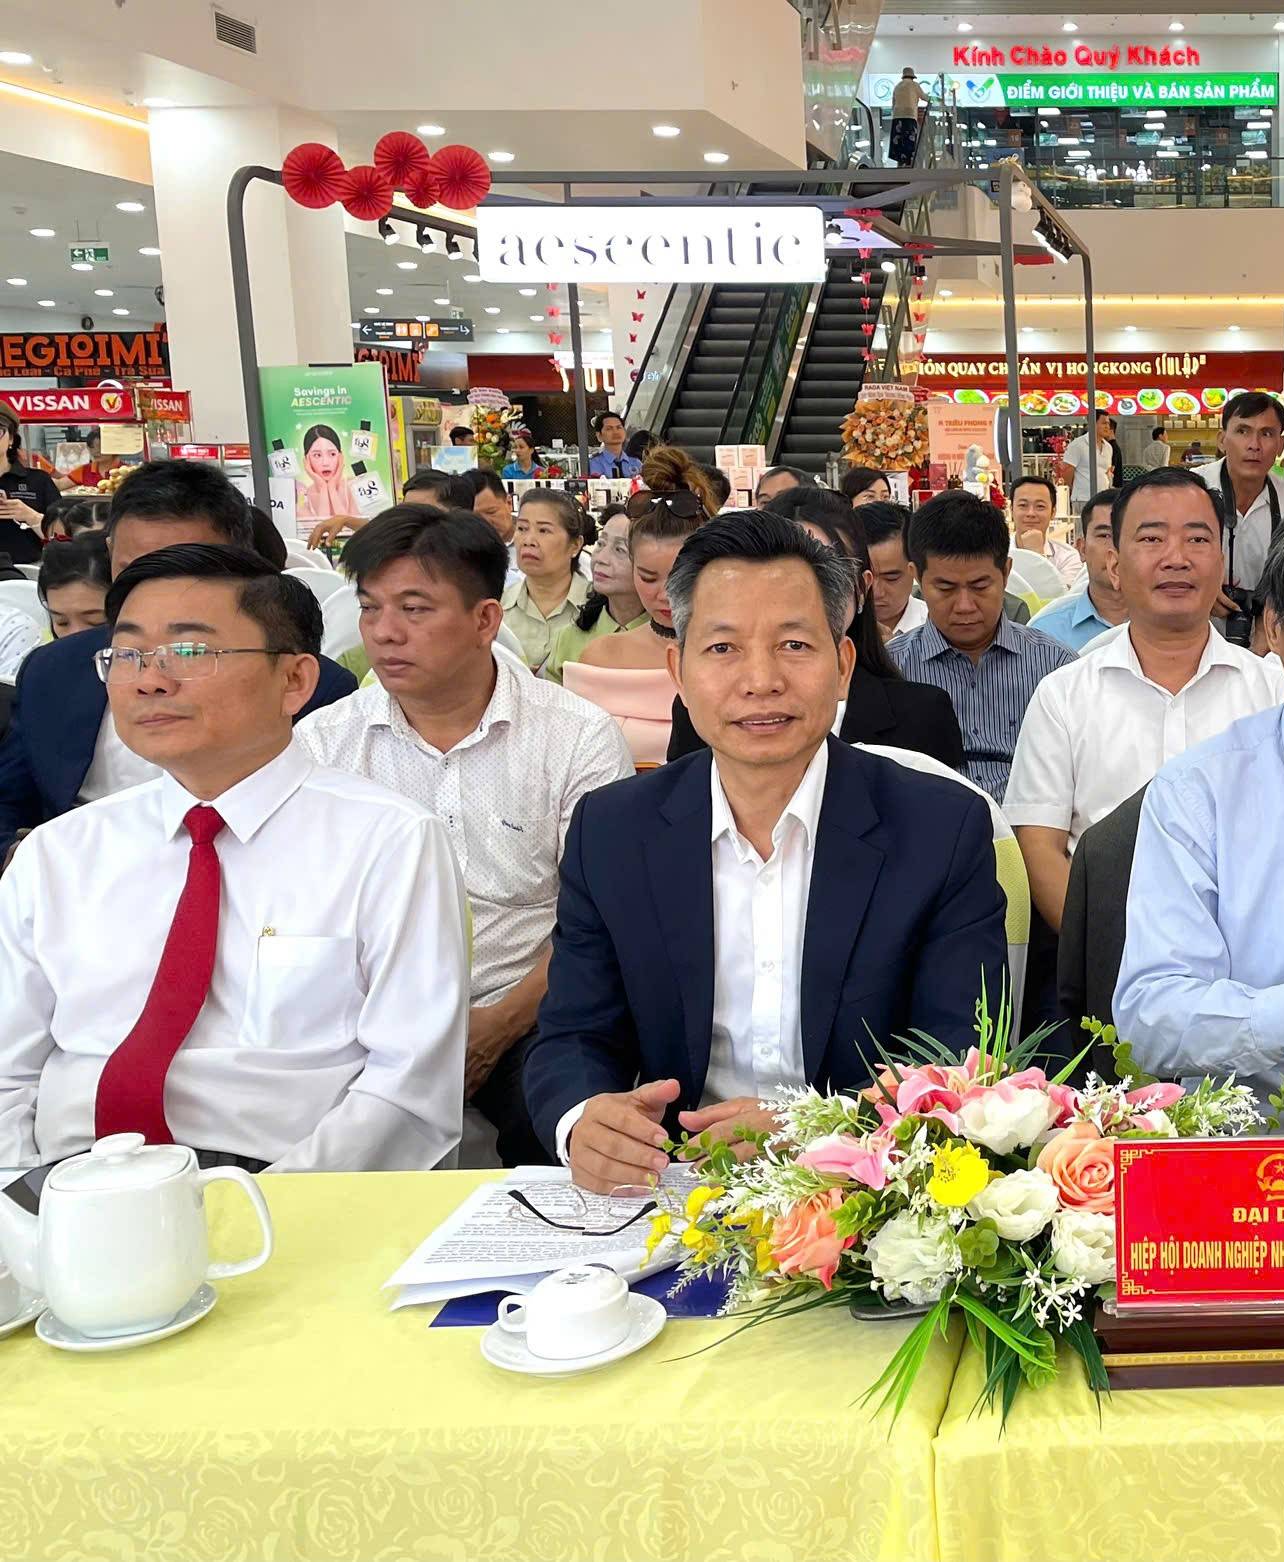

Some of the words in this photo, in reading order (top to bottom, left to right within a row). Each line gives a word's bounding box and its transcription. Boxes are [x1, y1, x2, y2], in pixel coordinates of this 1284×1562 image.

[952, 45, 1005, 66] Kính
[1010, 45, 1068, 66] Chào
[1074, 45, 1121, 70] Quý
[1127, 45, 1200, 66] Khách
[1006, 79, 1044, 99] ĐIỂM
[1048, 81, 1083, 100] GIỚI
[1087, 82, 1128, 103] THIỆU
[1132, 81, 1154, 99] VÀ
[1159, 80, 1189, 100] BÁN
[1194, 80, 1225, 100] SẢN
[1229, 77, 1275, 99] PHẨM
[499, 221, 801, 266] aescentic
[947, 361, 985, 377] QUAY
[988, 356, 1041, 376] CHẨN
[1045, 362, 1063, 378] VỊ
[9, 394, 90, 412] VISSAN
[290, 396, 353, 408] AESCENTIC
[293, 386, 335, 399] Savings
[337, 386, 348, 395] in
[1232, 1206, 1269, 1226] ĐẠI
[1130, 1236, 1158, 1276] HIỆP
[1160, 1235, 1180, 1276] HỘI
[1182, 1240, 1222, 1270] DOANH
[1225, 1235, 1268, 1275] NGHIỆP
